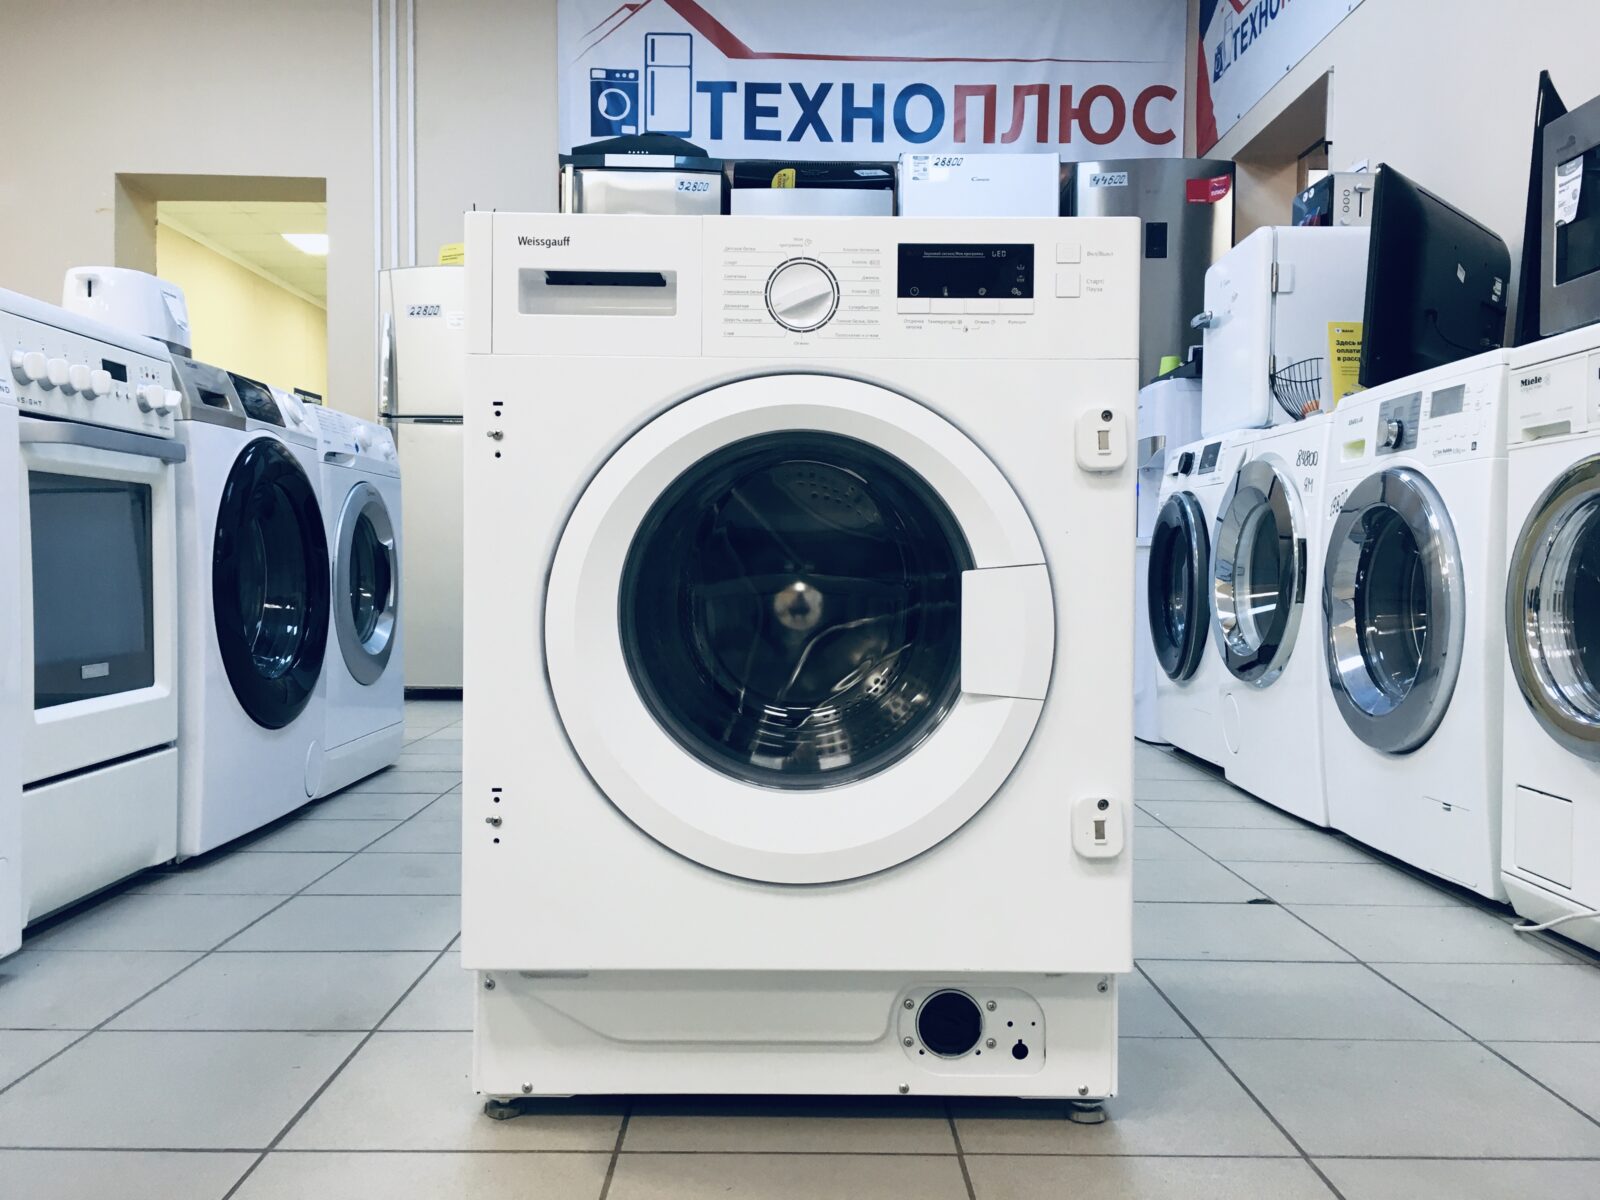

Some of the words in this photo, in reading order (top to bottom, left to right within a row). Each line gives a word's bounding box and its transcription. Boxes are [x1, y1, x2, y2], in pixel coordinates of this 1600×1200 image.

[696, 81, 1177, 146] ТЕХНОПЛЮС
[934, 157, 964, 167] 28800
[678, 181, 709, 192] 32800
[518, 236, 570, 248] Weissgauff
[410, 305, 440, 316] 22800
[1520, 376, 1543, 387] Miele
[1296, 449, 1319, 467] 84800
